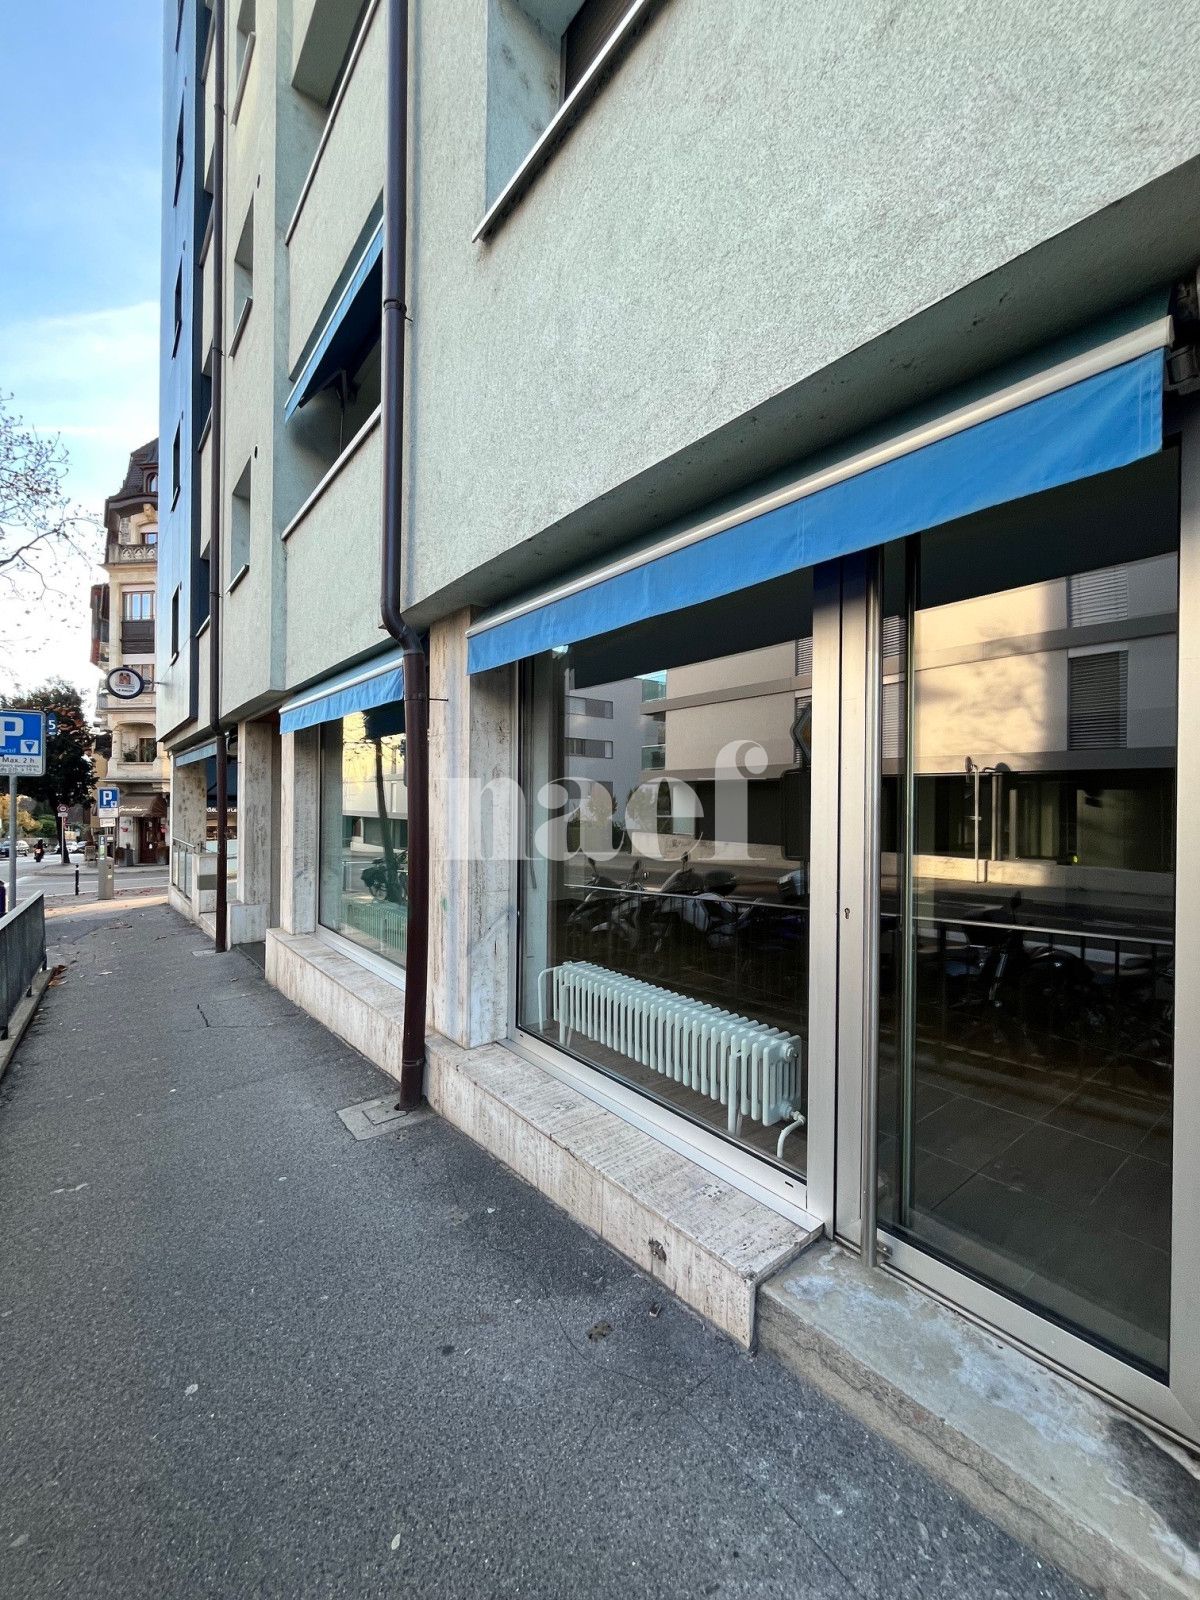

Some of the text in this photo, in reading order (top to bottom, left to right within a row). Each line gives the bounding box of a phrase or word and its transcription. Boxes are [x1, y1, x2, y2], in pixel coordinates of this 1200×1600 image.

[0, 716, 24, 746] P
[48, 719, 56, 730] 5
[2, 756, 21, 764] Max.
[102, 790, 113, 806] P
